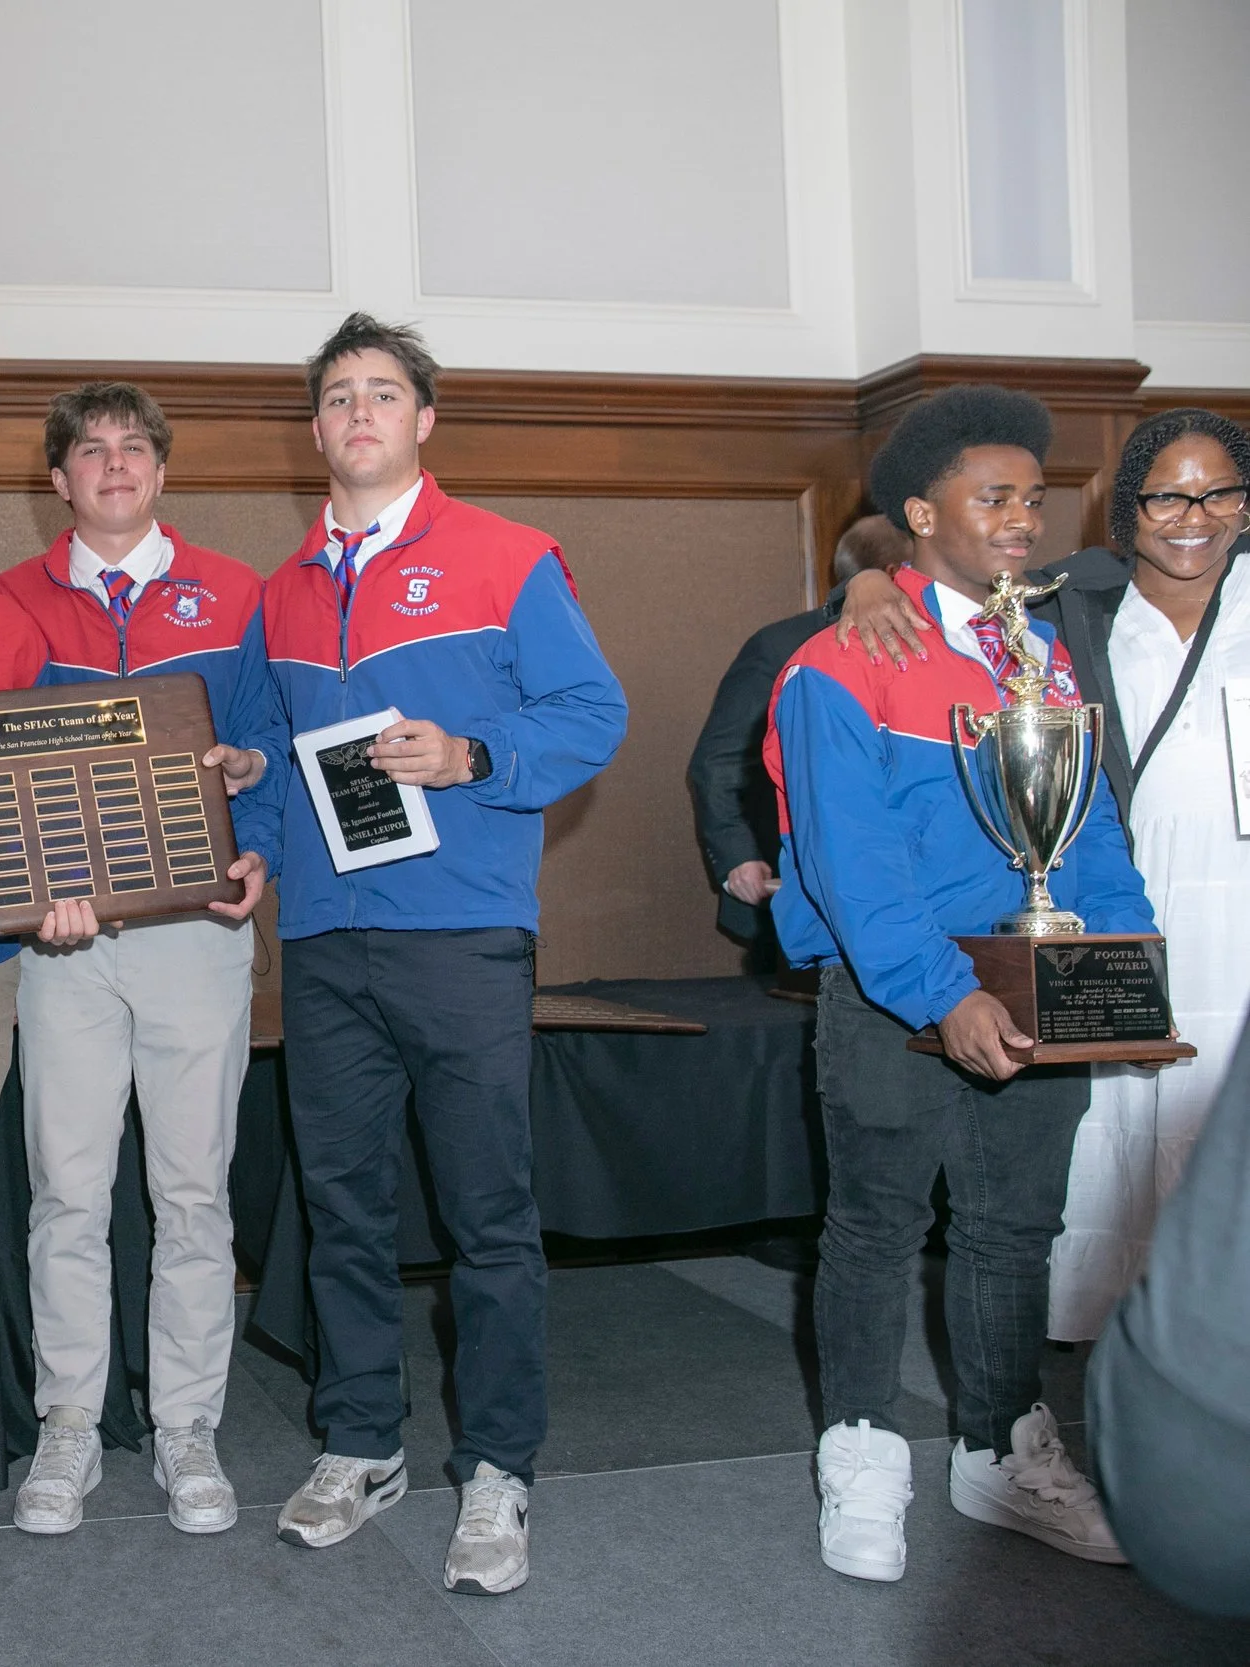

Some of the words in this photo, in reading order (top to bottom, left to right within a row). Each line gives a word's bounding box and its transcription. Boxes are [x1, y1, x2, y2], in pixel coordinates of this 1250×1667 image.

[175, 583, 218, 602] IGNATIUS
[391, 602, 440, 616] ATHLETICS
[163, 612, 212, 627] ATHLETICS
[3, 723, 22, 732] The
[23, 719, 57, 730] SFIAC
[58, 717, 85, 727] Team
[86, 714, 96, 724] of
[97, 713, 113, 722] the
[114, 712, 136, 721] Year
[6, 741, 19, 749] San
[20, 739, 48, 748] Francisco
[48, 736, 64, 746] High
[64, 734, 84, 743] School
[350, 776, 370, 787] SFIAC
[331, 789, 350, 799] TEAM
[361, 782, 374, 791] THE
[341, 821, 350, 829] St.
[351, 814, 377, 827] Ignatius
[377, 807, 404, 820] Football
[374, 820, 410, 835] LEUPOL
[370, 836, 389, 844] Captain
[1094, 950, 1159, 960] FOOTBALL
[1106, 962, 1148, 971] AWARD
